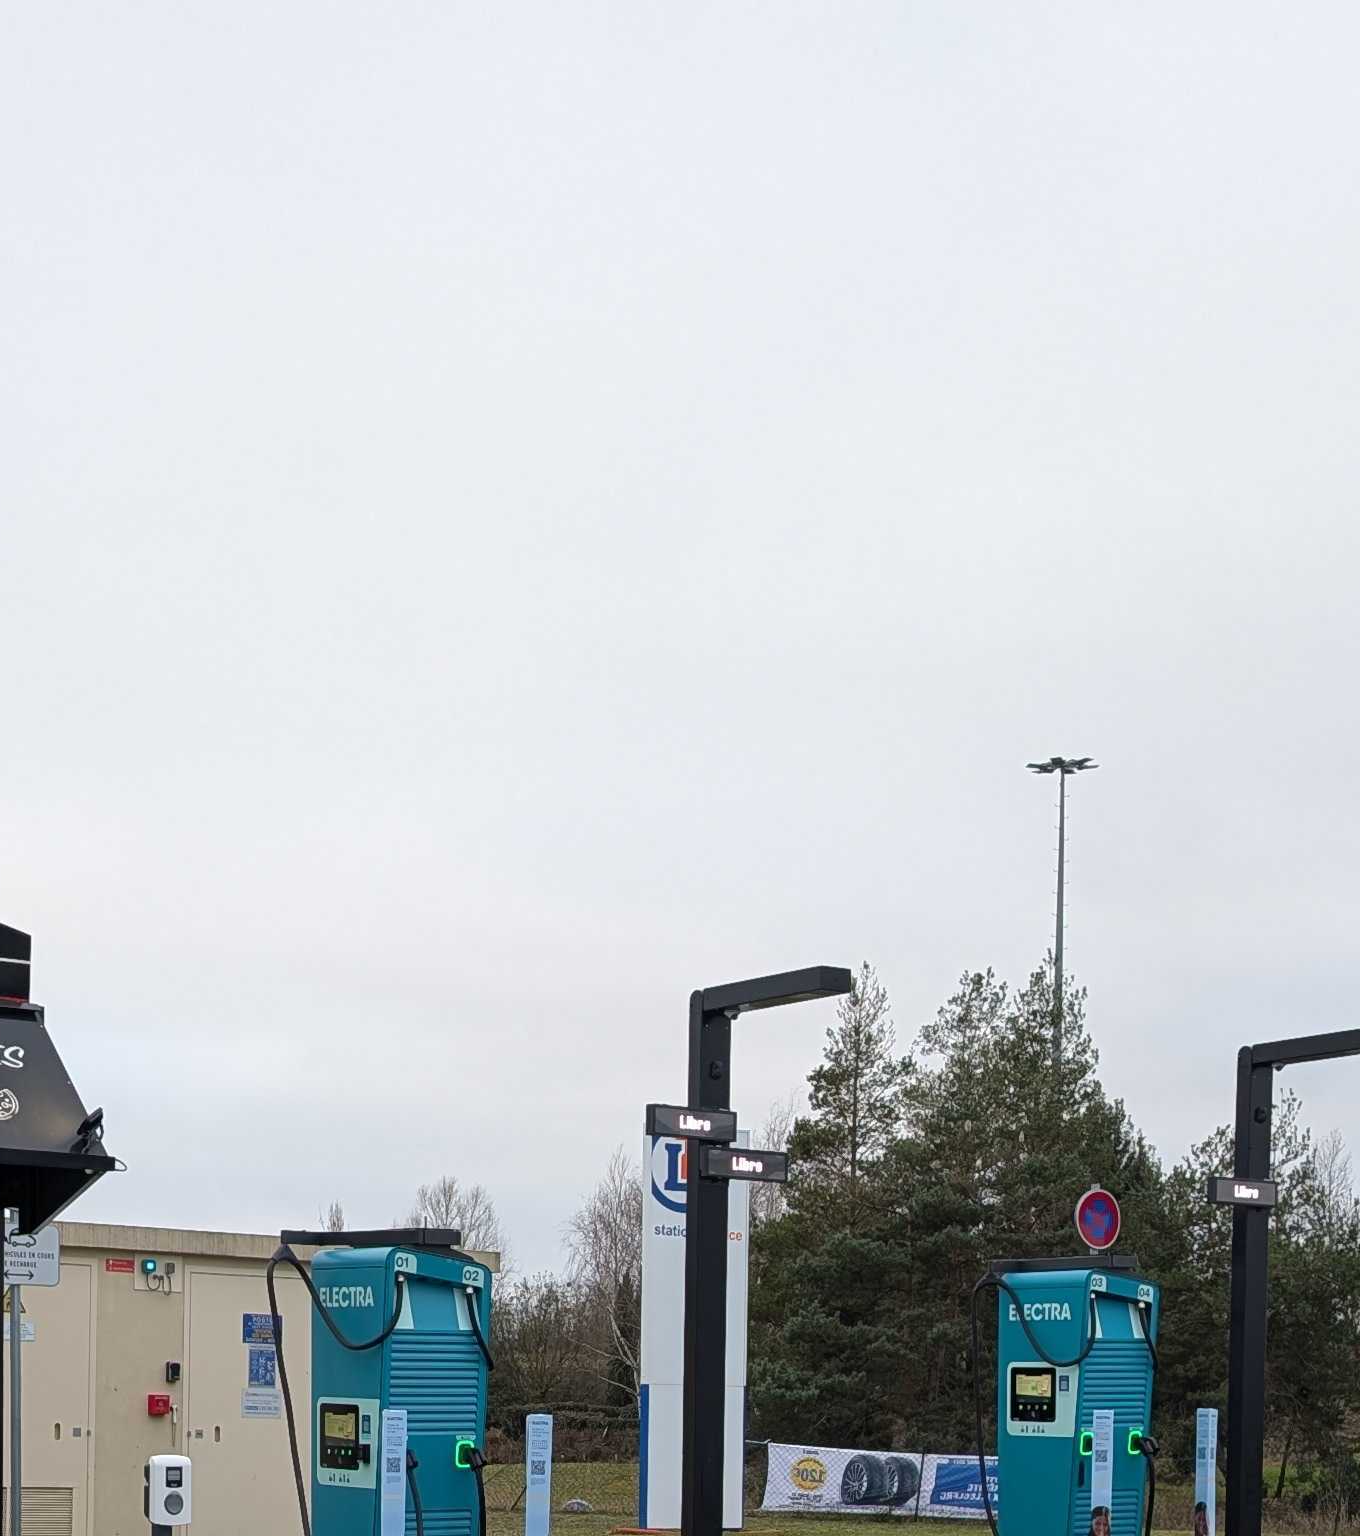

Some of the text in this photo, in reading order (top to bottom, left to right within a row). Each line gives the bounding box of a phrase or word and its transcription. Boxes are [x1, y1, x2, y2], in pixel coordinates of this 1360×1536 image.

[679, 1114, 712, 1132] Libre
[731, 1156, 764, 1173] Libre
[654, 1224, 686, 1238] statio
[395, 1256, 409, 1268] 01
[463, 1269, 480, 1282] 02
[1091, 1277, 1103, 1288] 03
[319, 1285, 375, 1308] ELECTRA
[1138, 1287, 1150, 1298] 04
